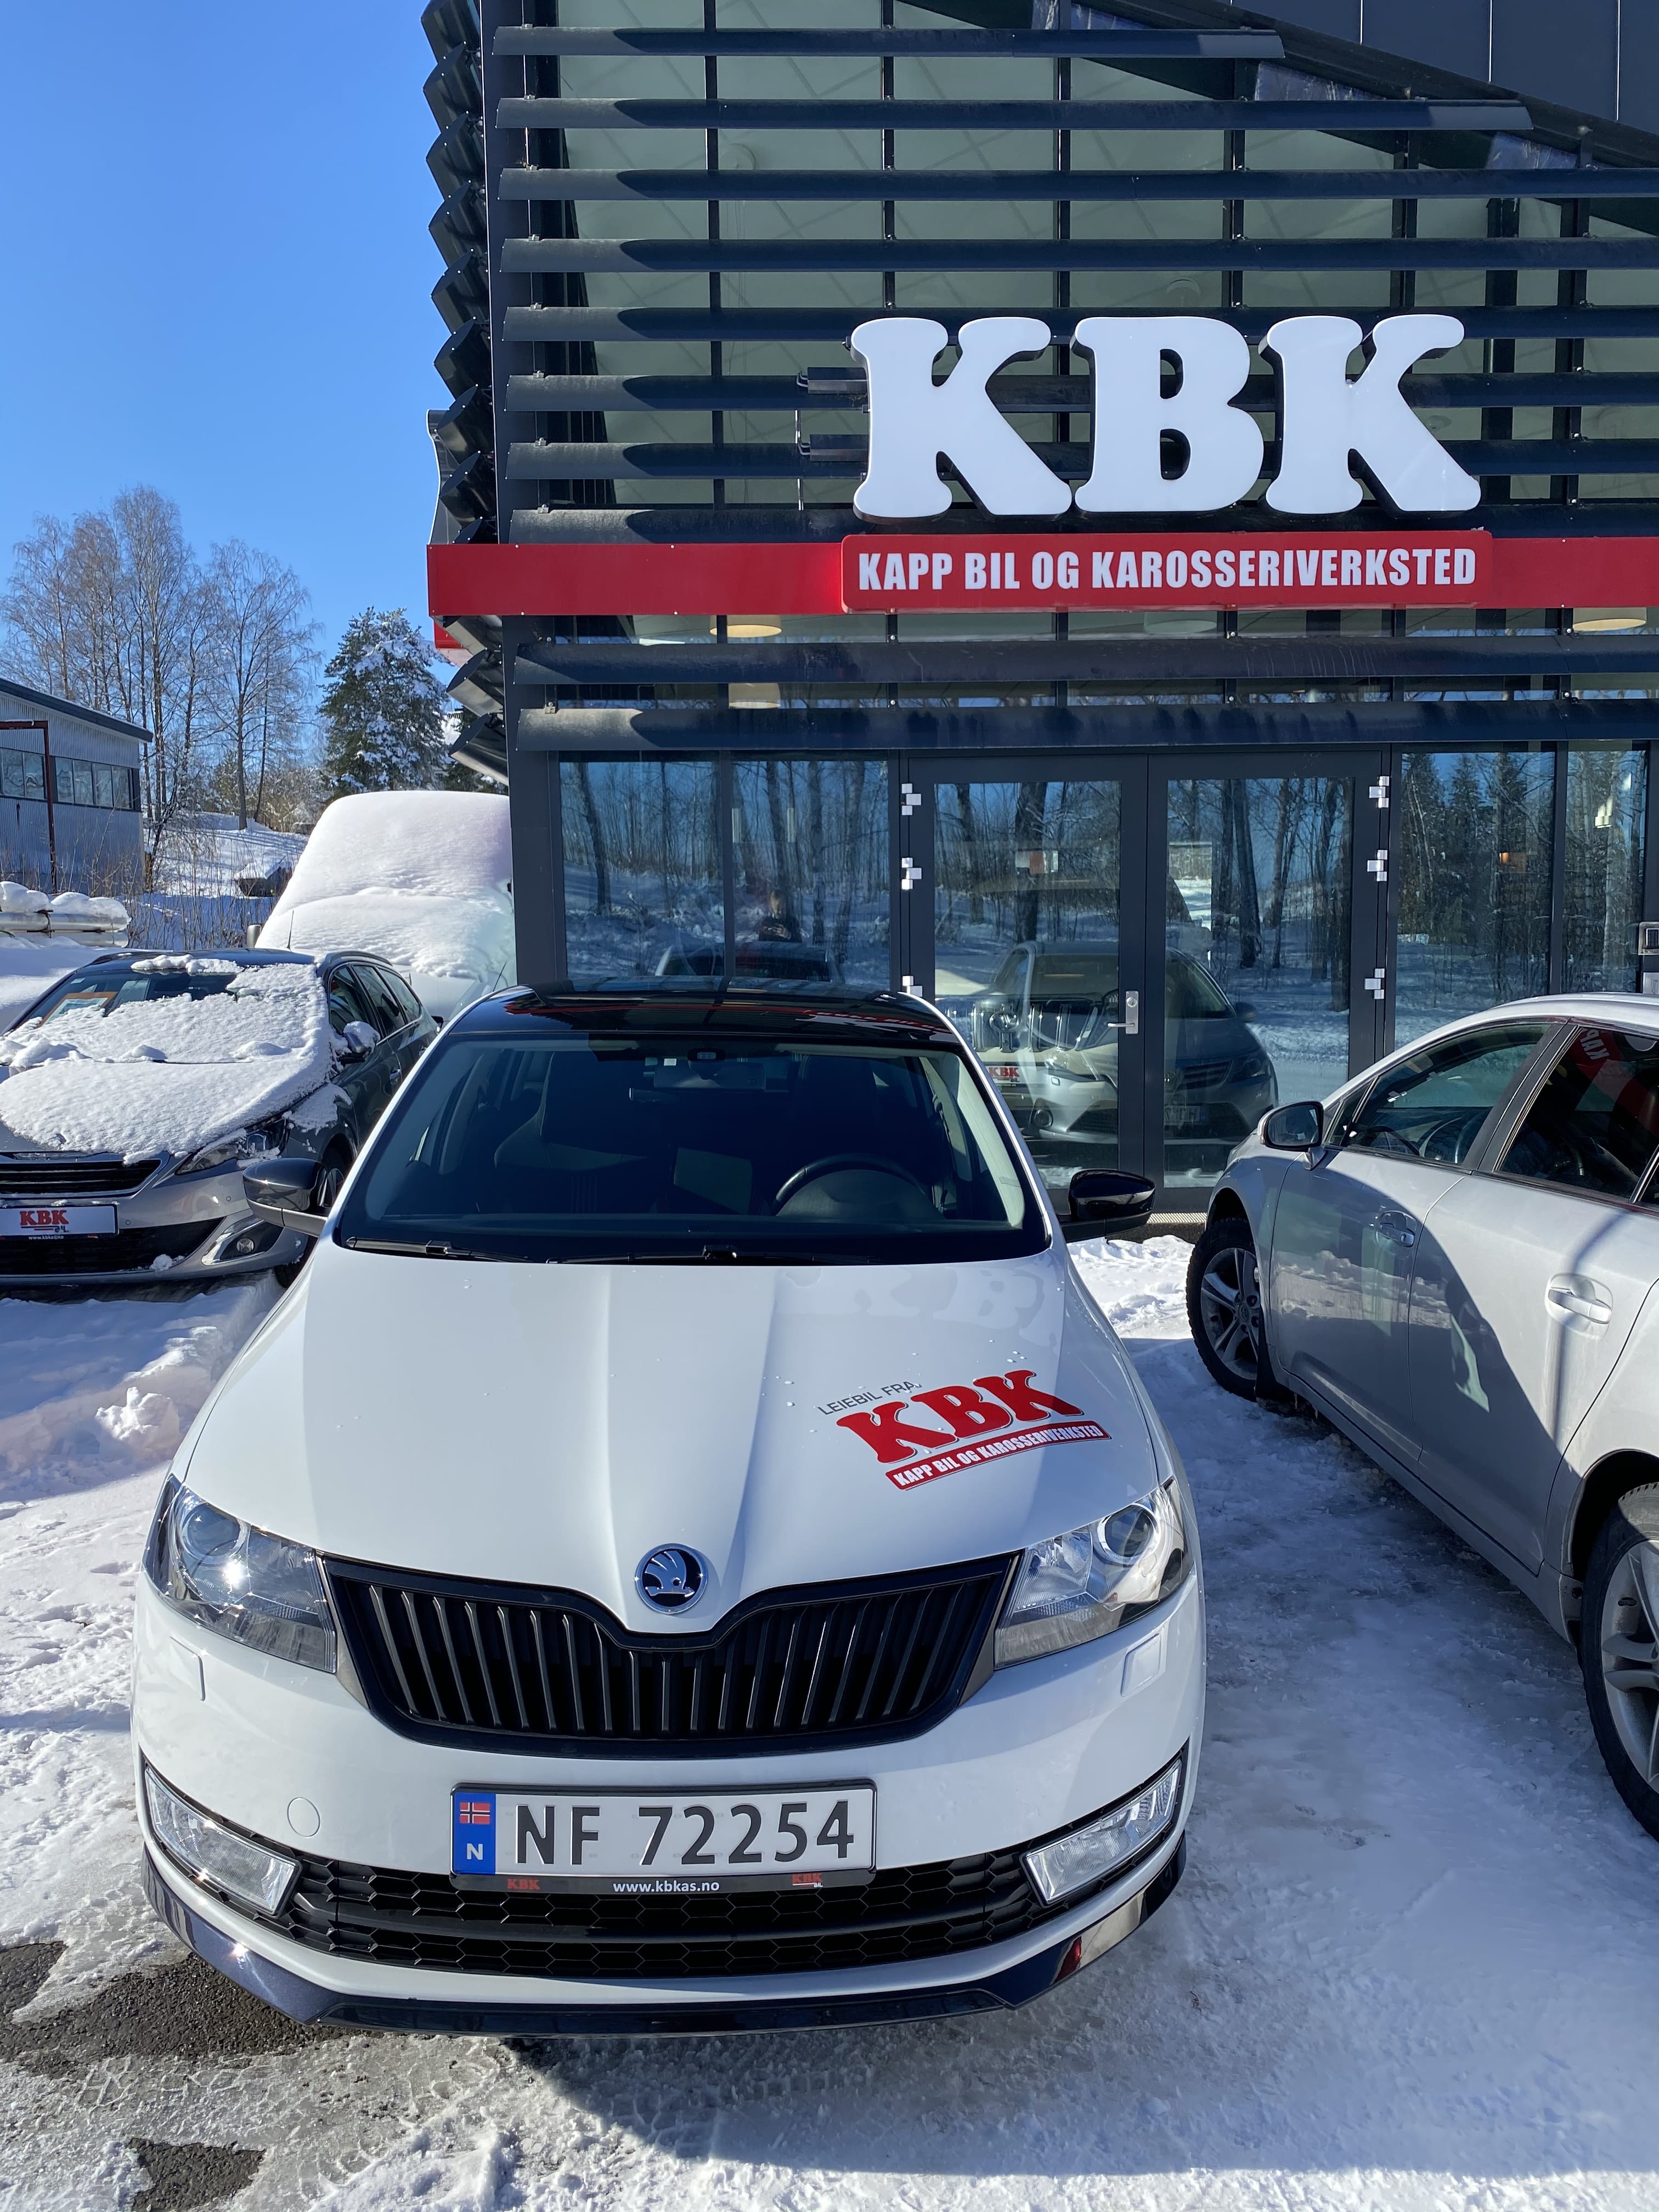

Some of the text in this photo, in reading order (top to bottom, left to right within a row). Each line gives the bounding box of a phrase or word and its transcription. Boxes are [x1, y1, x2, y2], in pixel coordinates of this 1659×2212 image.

[851, 314, 1481, 520] KBK
[858, 548, 1476, 591] KAPP BIL OG KAROSSERIVERKSTED
[988, 1067, 1020, 1077] KBK
[20, 1210, 69, 1226] KBK
[817, 1381, 918, 1415] LEIEBIL FRA
[837, 1370, 1084, 1464] KBK
[893, 1425, 1104, 1486] KAPP BIL OG KAROSSERIVERKSTED
[515, 1800, 855, 1866] NF 72254
[466, 1843, 483, 1861] N
[507, 1878, 540, 1890] KBK
[613, 1880, 720, 1894] www.kbkas.no
[792, 1873, 823, 1883] KBK
